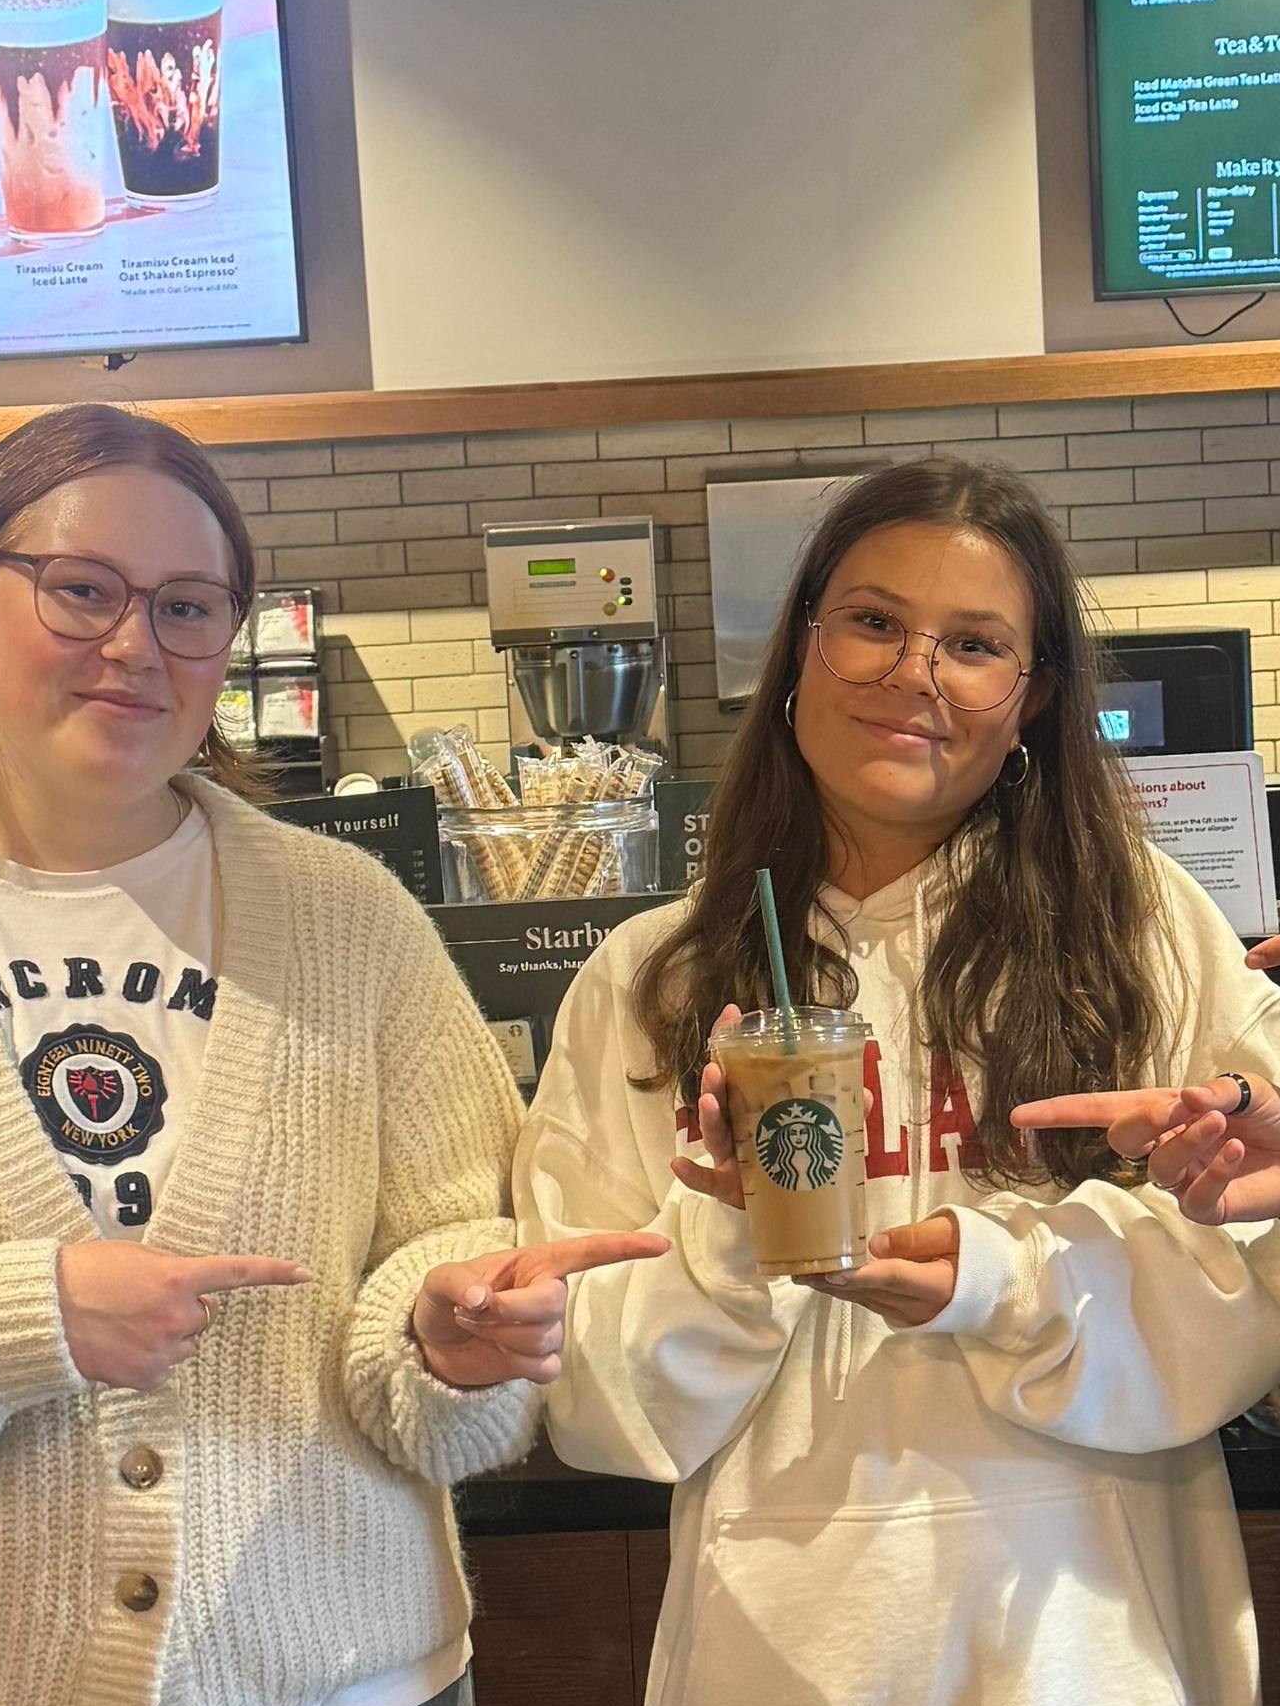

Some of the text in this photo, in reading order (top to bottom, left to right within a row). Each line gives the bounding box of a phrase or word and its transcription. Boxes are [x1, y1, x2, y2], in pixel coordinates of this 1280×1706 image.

[1214, 37, 1248, 55] Tea
[1248, 36, 1264, 53] &
[1134, 78, 1159, 92] Iced
[1160, 77, 1202, 91] Matcha
[1203, 75, 1239, 89] Green
[1239, 73, 1260, 86] Tea
[1135, 98, 1239, 115] Iced Chai Tea Latte
[1216, 158, 1260, 178] Make
[1261, 157, 1273, 175] it
[16, 261, 103, 275] Tiramisu Cream
[121, 253, 235, 269] Tiramisu Cream Iced
[32, 275, 88, 287] Iced Latte
[119, 271, 140, 282] Oat
[143, 269, 183, 281] Shaken
[1170, 780, 1206, 792] about
[334, 813, 400, 833] Yourself
[499, 963, 519, 974] Say
[521, 960, 562, 972] thanks,
[75, 1038, 134, 1064] NINETY
[132, 1063, 153, 1097] TWO
[61, 1119, 140, 1148] NEW YORK
